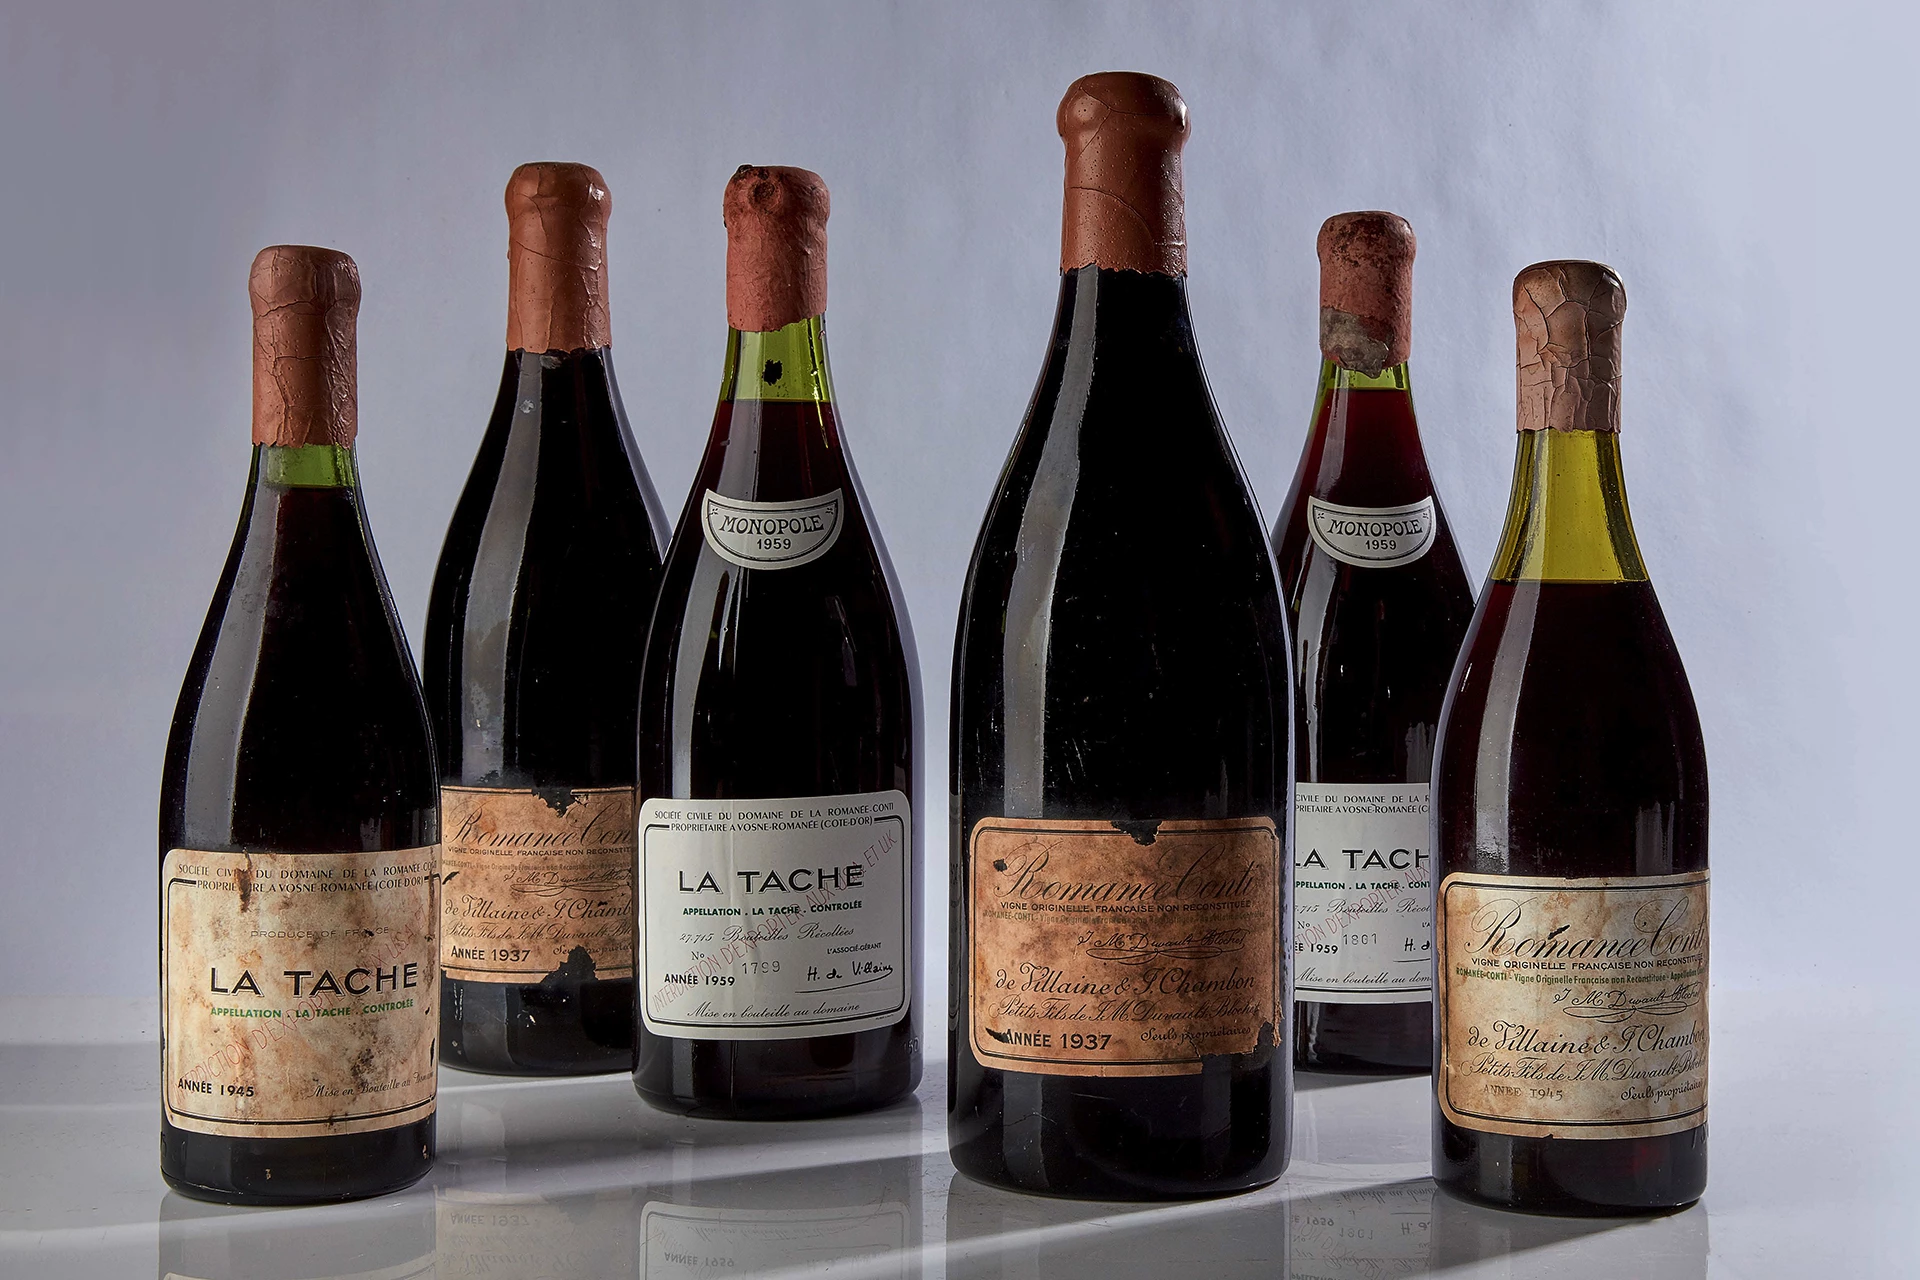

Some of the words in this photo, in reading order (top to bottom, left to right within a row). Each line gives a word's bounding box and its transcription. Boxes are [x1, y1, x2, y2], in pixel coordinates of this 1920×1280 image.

[719, 515, 824, 535] MONOPOLE
[1328, 519, 1422, 537] MONOPOLE
[757, 539, 791, 549] 1959
[1366, 540, 1396, 550] 1959
[687, 812, 712, 820] CIVILE
[719, 812, 732, 820] DU
[738, 811, 783, 820] DOMAINE
[791, 810, 803, 818] DE
[828, 803, 894, 816] ROMANÉE-CONTI
[737, 821, 818, 831] VOSNE-ROMANÉE
[470, 848, 512, 856] ORIGINELLE
[256, 869, 272, 879] DU
[281, 869, 333, 879] DOMAINE
[343, 868, 356, 878] DE
[365, 867, 376, 877] LA
[679, 871, 723, 894] LA
[737, 864, 864, 894] TACHE
[806, 882, 835, 908] AUX
[864, 845, 879, 868] ET
[1371, 882, 1399, 890] TACHE
[445, 899, 458, 914] de
[462, 895, 529, 919] Villaine
[532, 906, 545, 919] &
[683, 908, 740, 916] APPELLATION
[752, 907, 765, 915] LA
[768, 906, 800, 915] TACHE
[811, 901, 862, 913] CONTROLÉE
[1001, 902, 1027, 910] VIGNE
[1031, 904, 1089, 912] ORIGINELLE
[1096, 904, 1154, 914] FRANÇAISE
[1158, 904, 1179, 912] NON
[1183, 899, 1251, 911] RECONSTITUÉE
[251, 930, 312, 938] PRODUCE
[722, 926, 788, 941] Bouteilles
[797, 922, 854, 939] Récoltées
[451, 946, 485, 960] ANNÉE
[493, 950, 530, 961] 1937
[1311, 944, 1338, 954] 1959
[1472, 959, 1499, 967] VIGNE
[1505, 961, 1565, 970] ORIGINELLE
[1572, 961, 1631, 971] FRANÇAISE
[211, 968, 264, 997] LA
[284, 962, 417, 997] TACHE
[664, 974, 698, 985] ANNÉE
[705, 976, 735, 986] 1959
[996, 969, 1015, 989] de
[1020, 962, 1110, 995] Villaine
[1114, 976, 1130, 994] &
[1296, 967, 1323, 982] Mise
[1343, 972, 1389, 984] bouteille
[1514, 974, 1533, 985] Vigne
[1536, 974, 1572, 985] Originelle
[211, 1007, 282, 1018] APPELLATION
[296, 1009, 310, 1018] LA
[316, 1007, 350, 1017] TACHE
[363, 999, 414, 1014] CONTROLÉE
[687, 1002, 719, 1018] Mise
[723, 1008, 737, 1018] en
[741, 1003, 789, 1019] bouteille
[794, 1009, 808, 1017] au
[813, 1004, 860, 1014] domaine
[1006, 1029, 1051, 1048] ANNÉE
[1062, 1033, 1112, 1050] 1937
[1141, 1028, 1177, 1042] Seuls
[1468, 1026, 1488, 1047] de
[1494, 1020, 1589, 1054] Villaine
[1594, 1036, 1609, 1054] &
[178, 1079, 212, 1094] ANNÉE
[220, 1084, 254, 1097] 1945
[307, 1085, 339, 1098] Mise
[342, 1087, 354, 1096] en
[1484, 1085, 1521, 1097] ANNEE
[1621, 1083, 1654, 1100] Seuls
